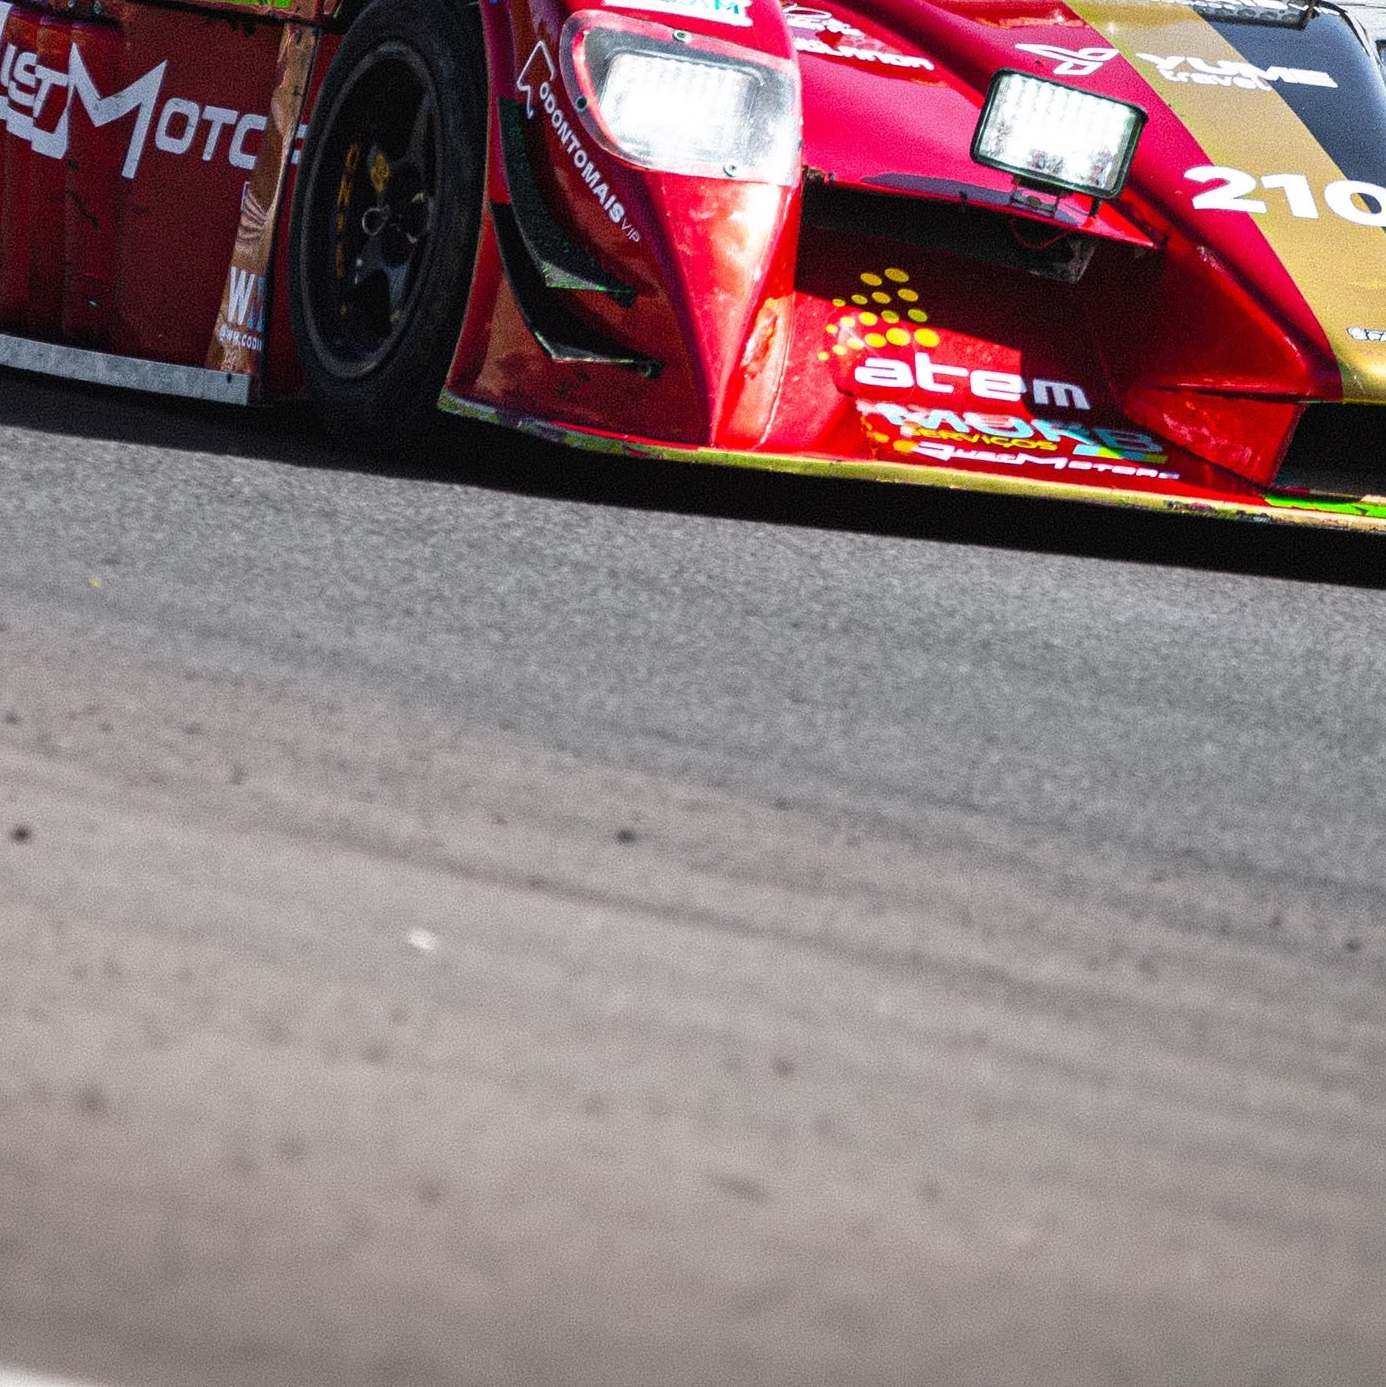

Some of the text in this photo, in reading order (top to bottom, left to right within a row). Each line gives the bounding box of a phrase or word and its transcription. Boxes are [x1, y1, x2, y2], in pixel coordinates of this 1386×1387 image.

[1135, 53, 1339, 88] YUME
[539, 81, 625, 223] ODONTOMAIS
[854, 352, 1091, 410] atem
